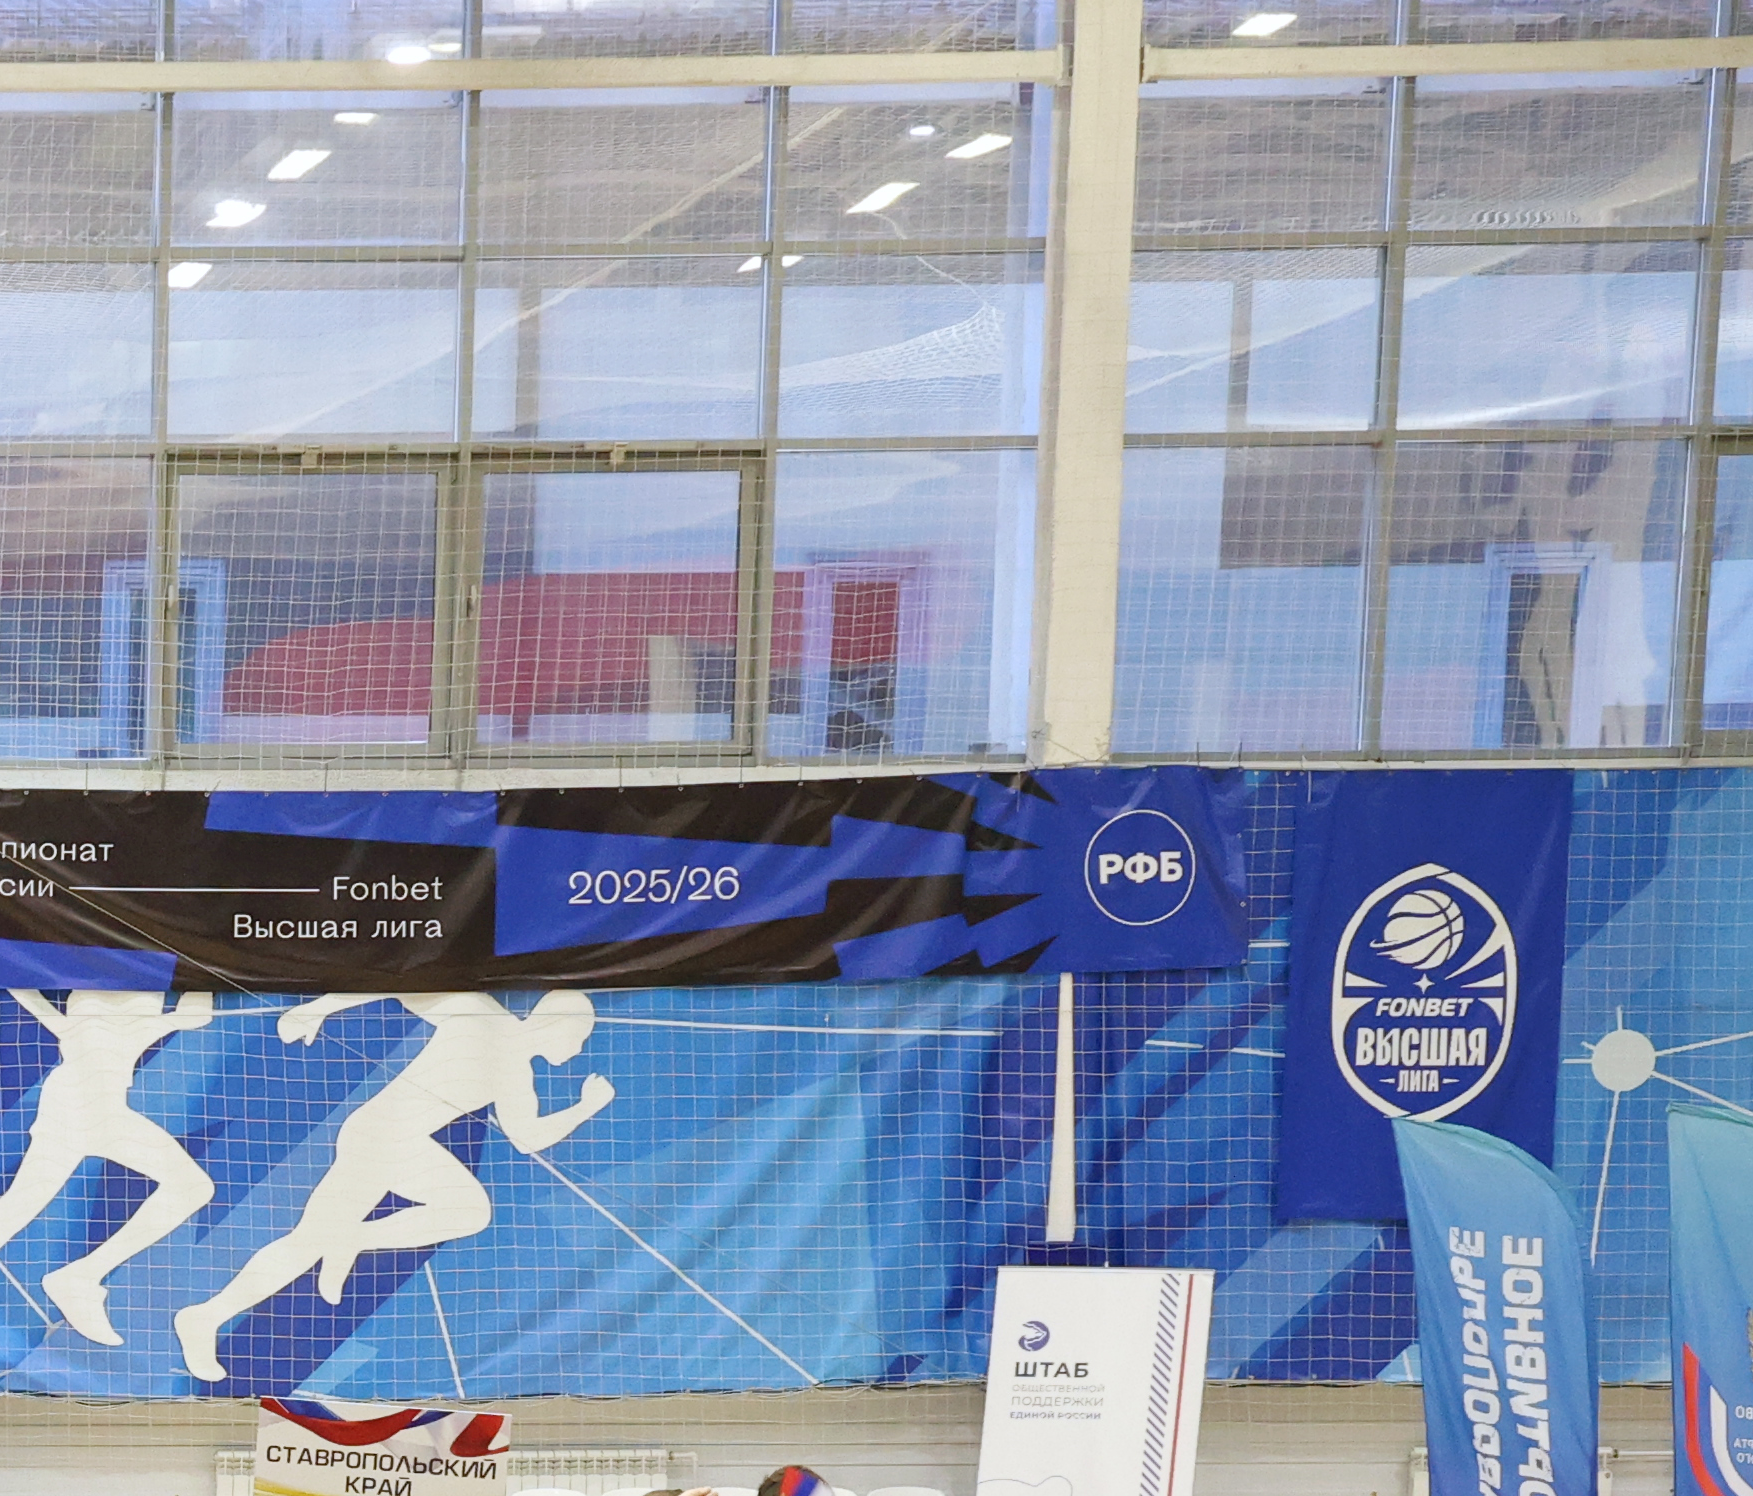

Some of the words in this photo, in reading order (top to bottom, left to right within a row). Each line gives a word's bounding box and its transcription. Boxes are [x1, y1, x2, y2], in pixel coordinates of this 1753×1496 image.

[1098, 851, 1184, 887] РФБ
[332, 874, 444, 902] Fonbet
[567, 866, 741, 906] 2025/26
[232, 914, 358, 940] Высшая
[371, 917, 444, 940] лига
[1375, 997, 1474, 1018] FONBET
[1355, 1027, 1487, 1067] ВЫСШАЯ
[1397, 1070, 1440, 1093] ЛИГА
[1014, 1362, 1089, 1378] ШТАБ
[1011, 1383, 1106, 1393] ОБЩЕСТВЕННОЙ
[1011, 1396, 1104, 1408] ПОДДЕРЖКИ
[1010, 1411, 1055, 1419] ЕДИНОЙ
[1057, 1411, 1102, 1420] РОССИИ
[266, 1444, 497, 1480] СТАВРОПОЛЬСКИЙ
